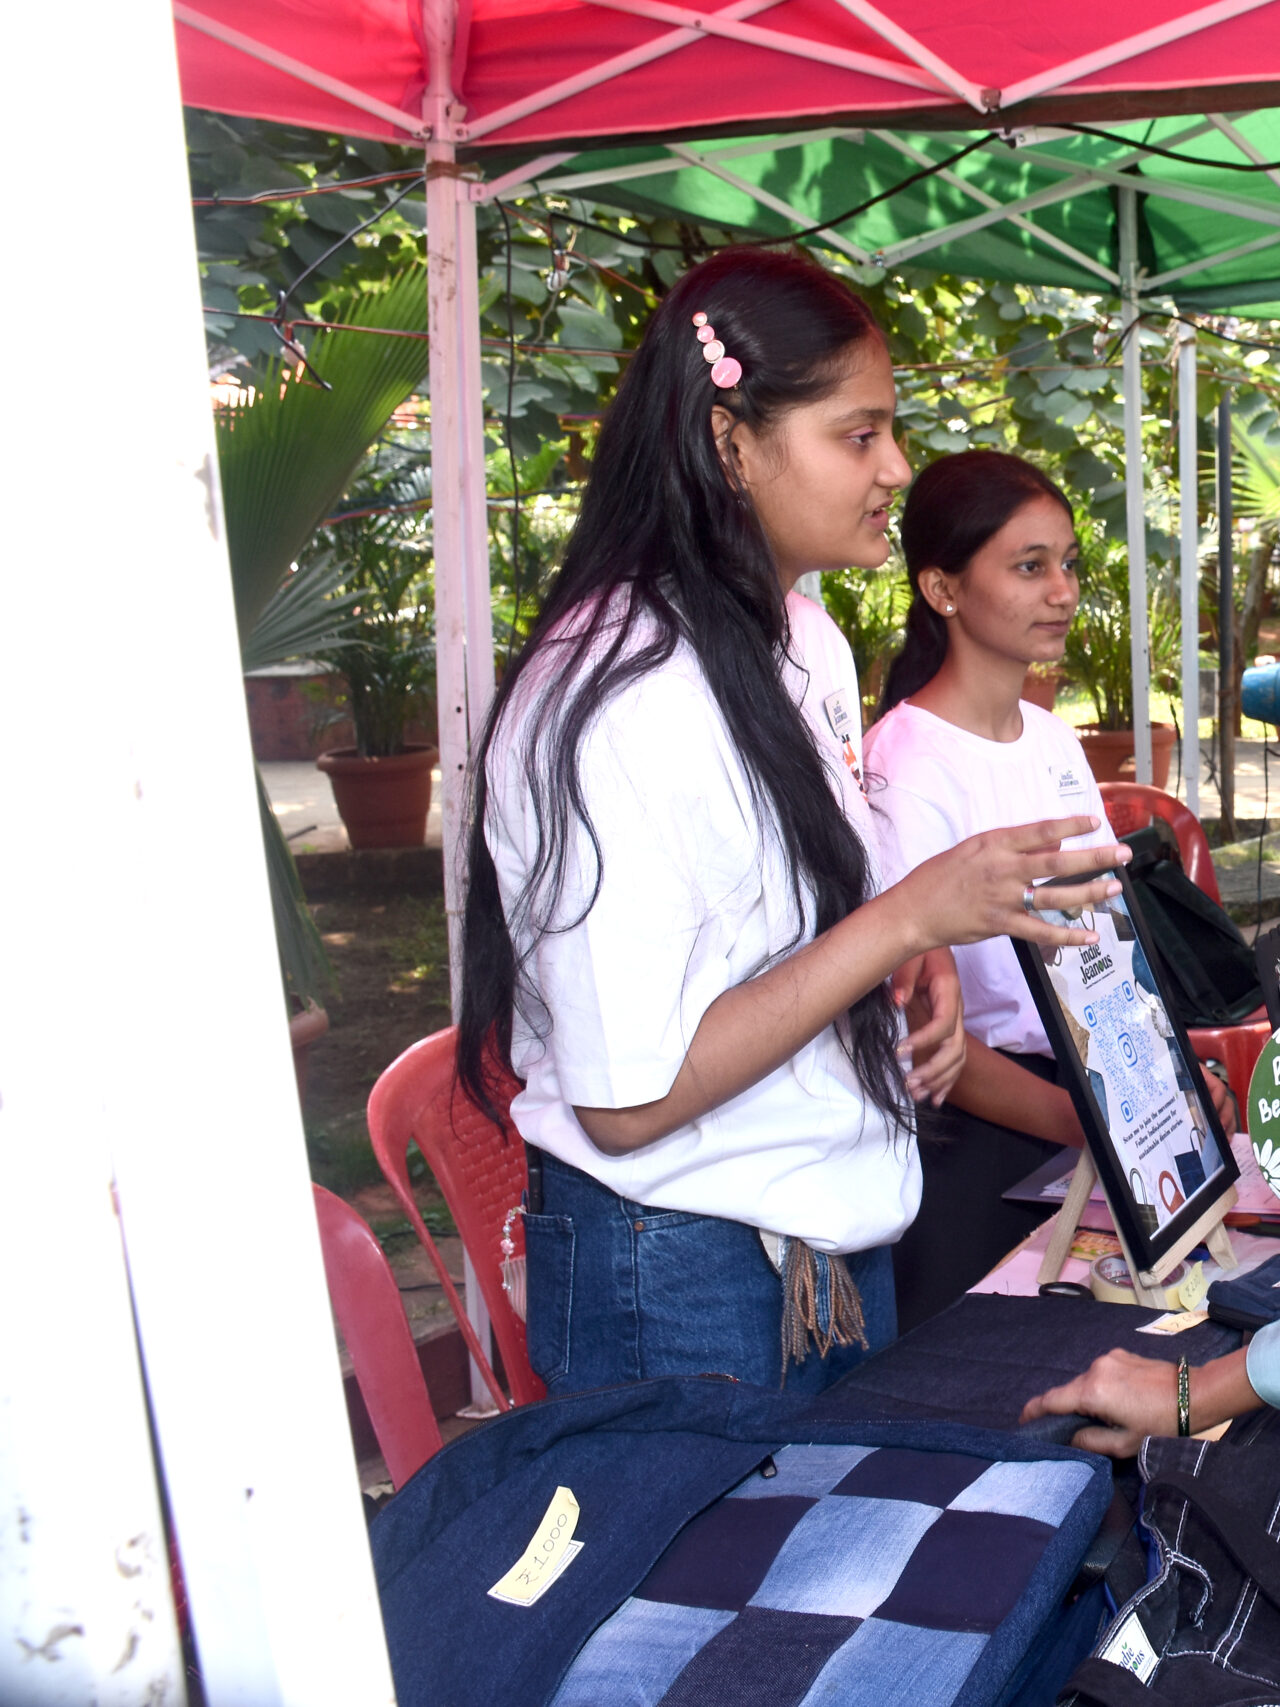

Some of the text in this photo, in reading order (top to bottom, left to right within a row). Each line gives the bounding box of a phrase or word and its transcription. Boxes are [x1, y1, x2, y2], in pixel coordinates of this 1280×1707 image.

[1079, 944, 1102, 965] indie
[1080, 955, 1113, 985] Jeanous
[1118, 1647, 1136, 1668] ndie
